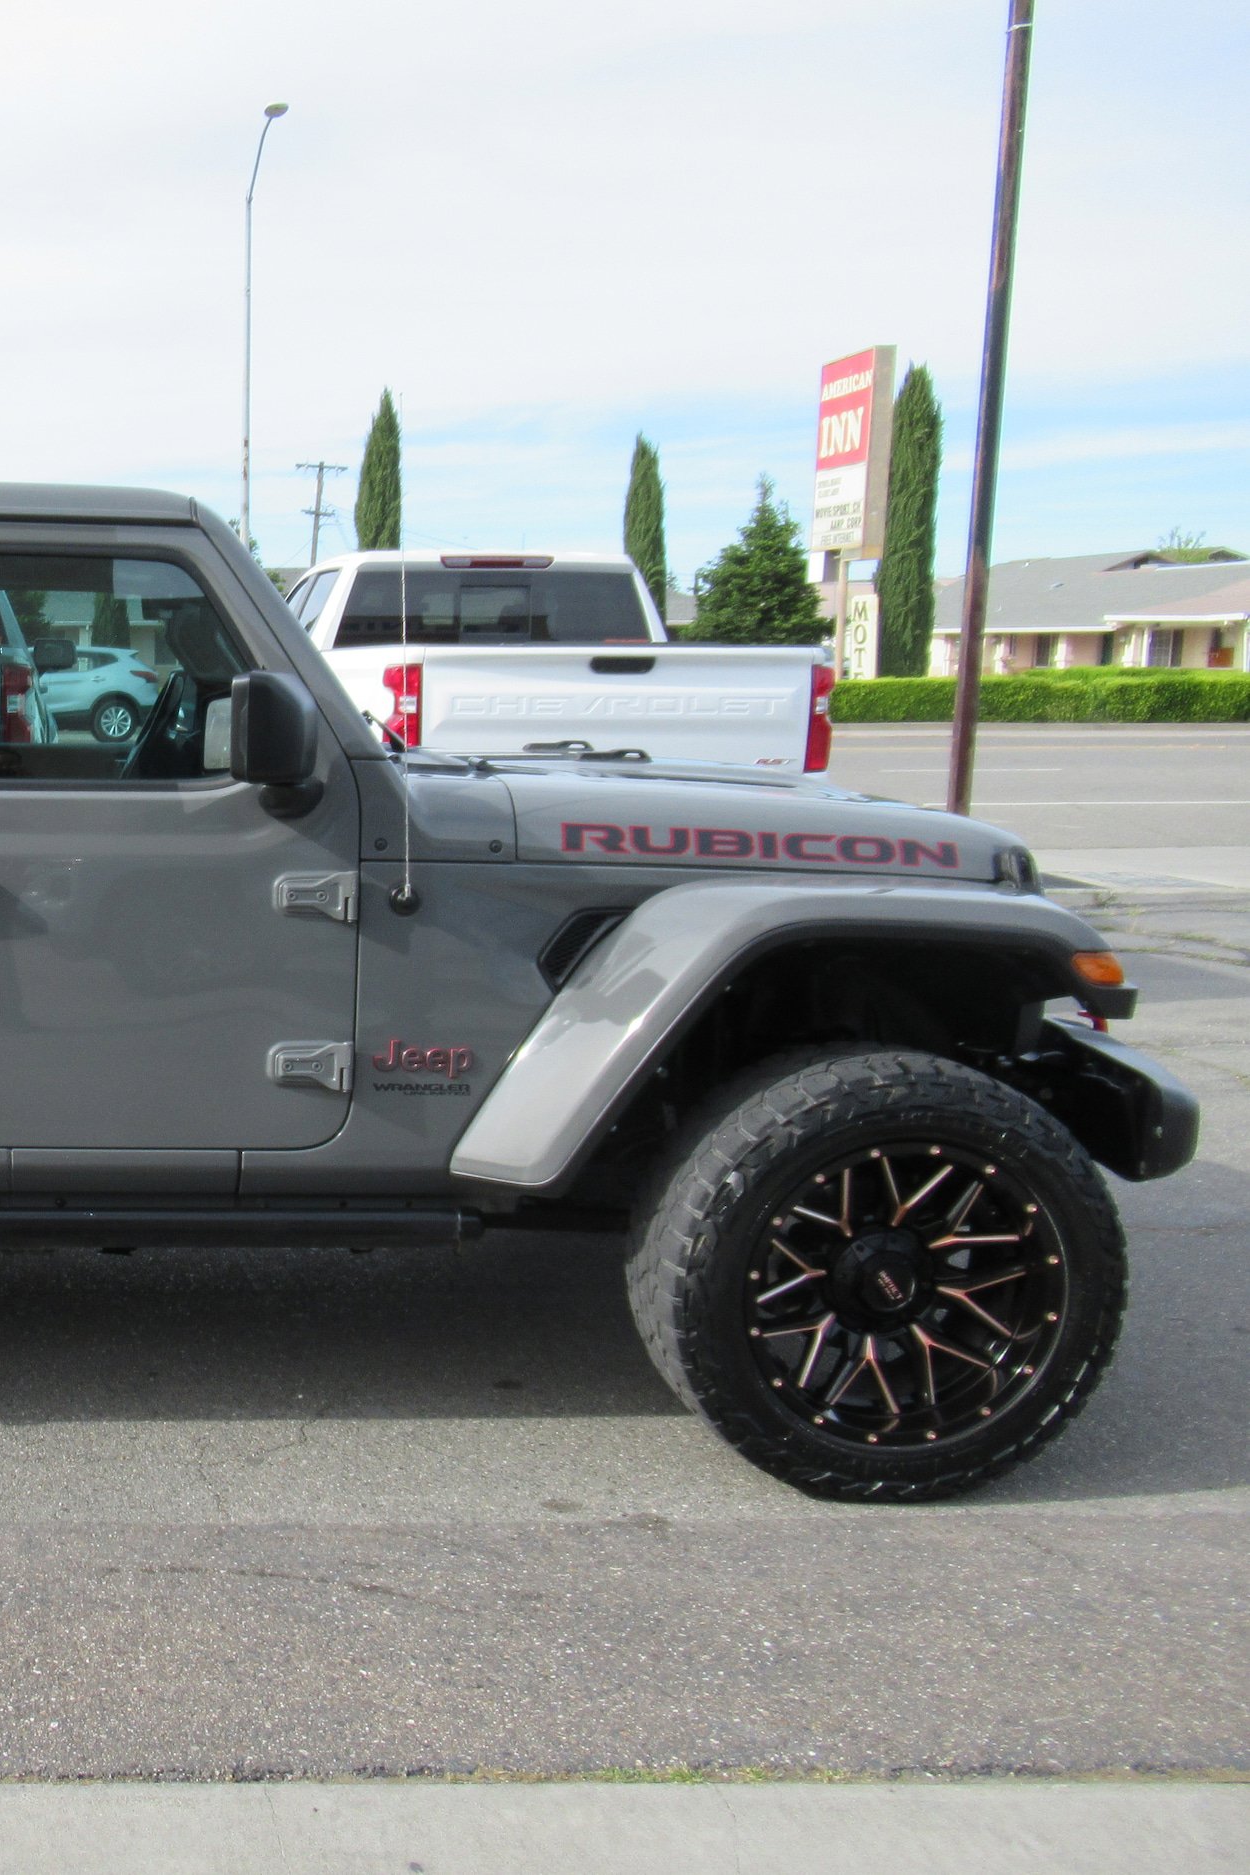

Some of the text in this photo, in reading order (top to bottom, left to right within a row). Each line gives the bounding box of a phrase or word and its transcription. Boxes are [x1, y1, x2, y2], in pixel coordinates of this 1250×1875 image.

[821, 369, 873, 402] AMERICAN
[819, 406, 864, 459] INN
[452, 695, 788, 716] CHEVROLET
[561, 822, 960, 868] RUBICON
[372, 1038, 474, 1079] Jeep
[372, 1082, 471, 1092] WRANGLER
